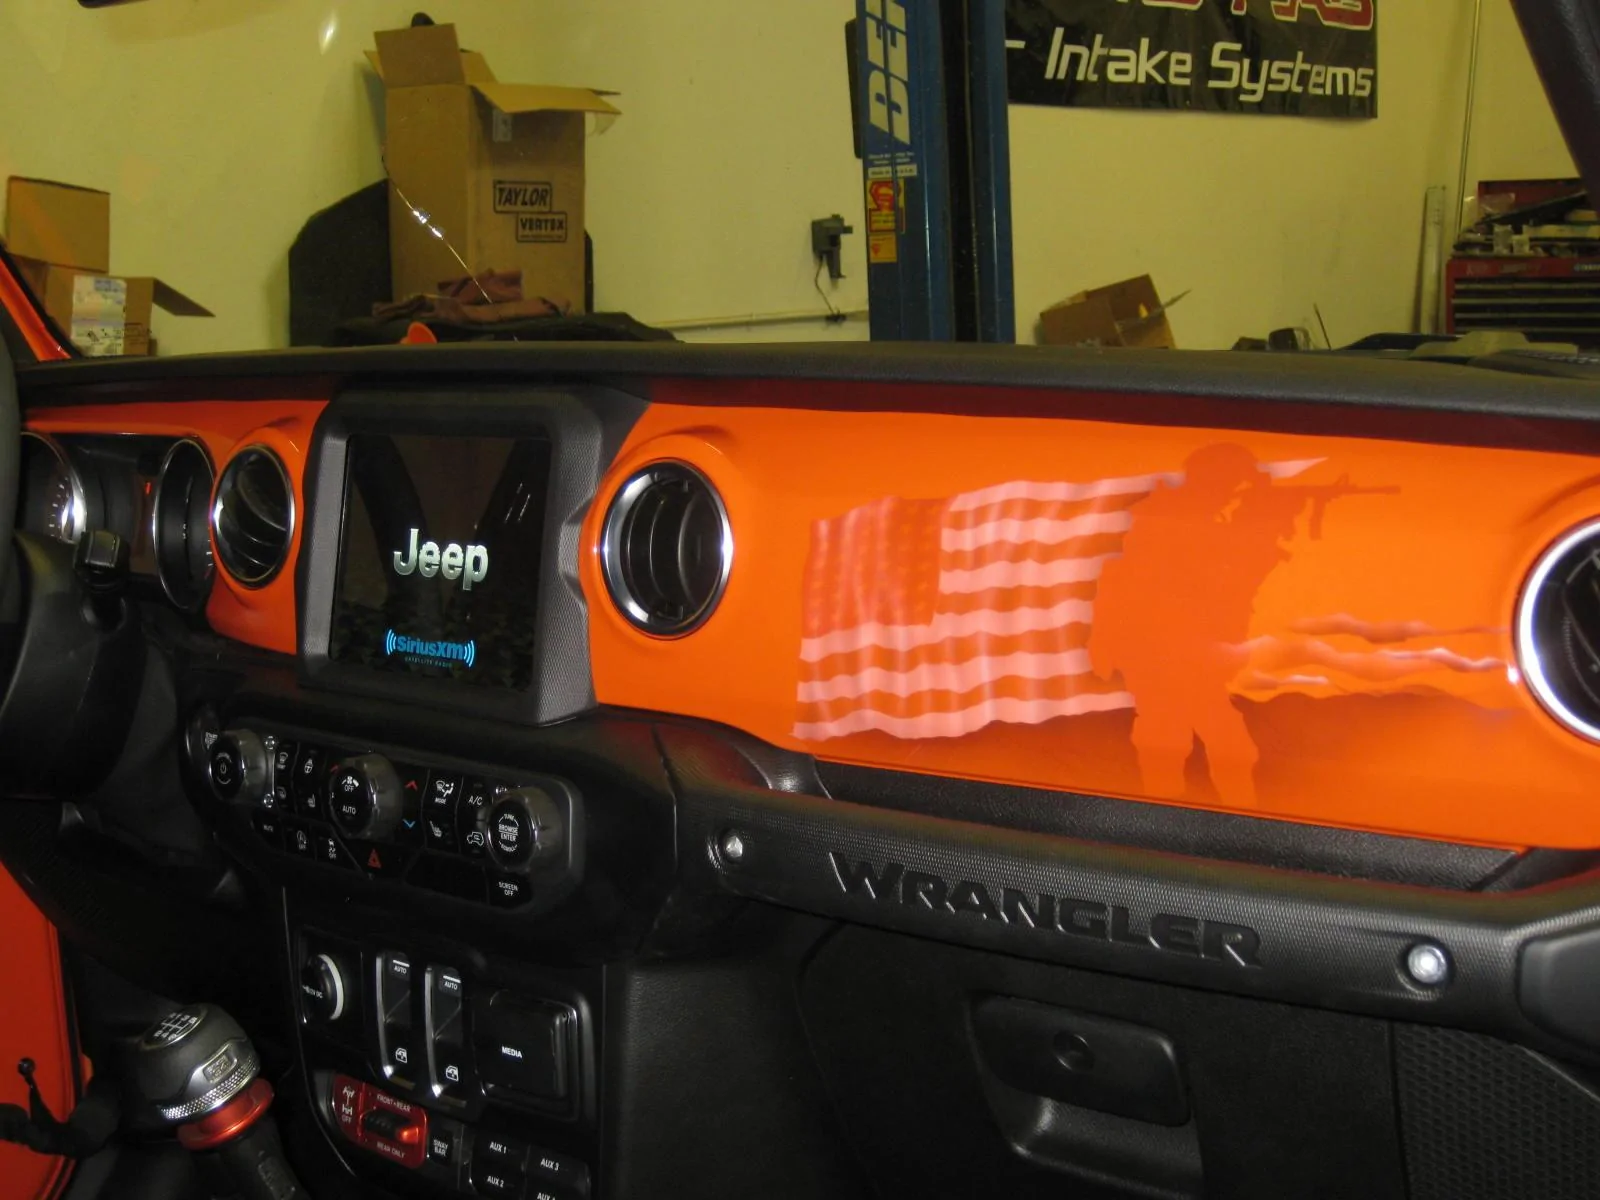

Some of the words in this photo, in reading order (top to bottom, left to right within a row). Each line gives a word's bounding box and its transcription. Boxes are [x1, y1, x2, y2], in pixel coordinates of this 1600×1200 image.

[1044, 27, 1192, 86] Intake
[1207, 42, 1374, 102] Systems
[497, 187, 549, 207] TAYLOR
[520, 217, 564, 232] VERTEX
[393, 528, 489, 591] Jeep
[344, 784, 354, 793] OFF
[468, 795, 483, 806] A/C
[342, 804, 356, 815] AUTO
[498, 823, 519, 835] BROWSE
[500, 833, 517, 843] ENTER
[498, 881, 519, 892] SCREEN
[504, 889, 514, 897] OFF
[828, 851, 1262, 969] WRANGLER
[393, 965, 407, 975] AUTO
[444, 981, 458, 991] AUTO
[501, 1046, 523, 1059] MEDIA
[391, 1145, 407, 1159] ONLY
[489, 1141, 503, 1153] AUX
[502, 1145, 507, 1154] 1
[540, 1157, 554, 1170] AUX
[554, 1161, 560, 1171] 3
[487, 1175, 500, 1187] AUX
[499, 1179, 505, 1189] 2
